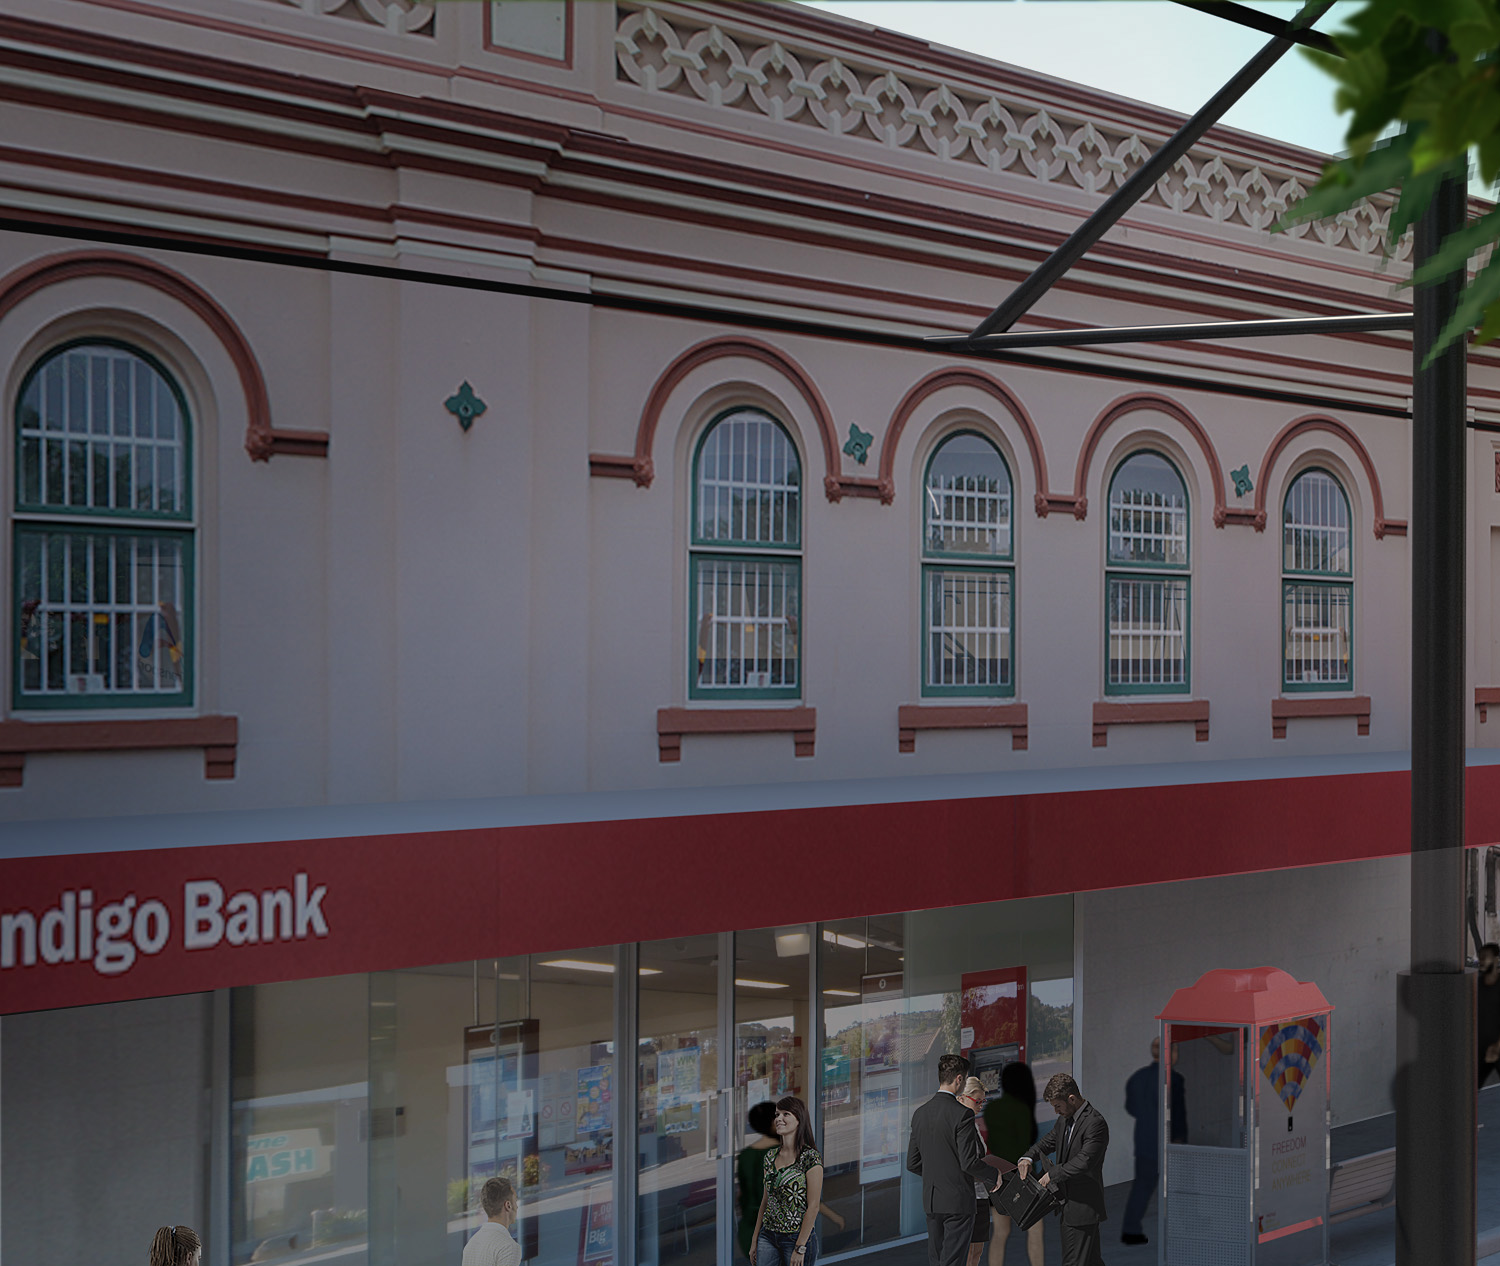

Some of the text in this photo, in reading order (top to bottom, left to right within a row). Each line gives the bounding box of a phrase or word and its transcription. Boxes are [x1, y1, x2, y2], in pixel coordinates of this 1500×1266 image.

[0, 872, 329, 974] ndigo Bank
[1271, 1135, 1307, 1156] FREEDOM
[1271, 1153, 1306, 1174] CONNECT
[1271, 1168, 1312, 1192] ANYWHERE
[588, 1229, 607, 1245] Big
